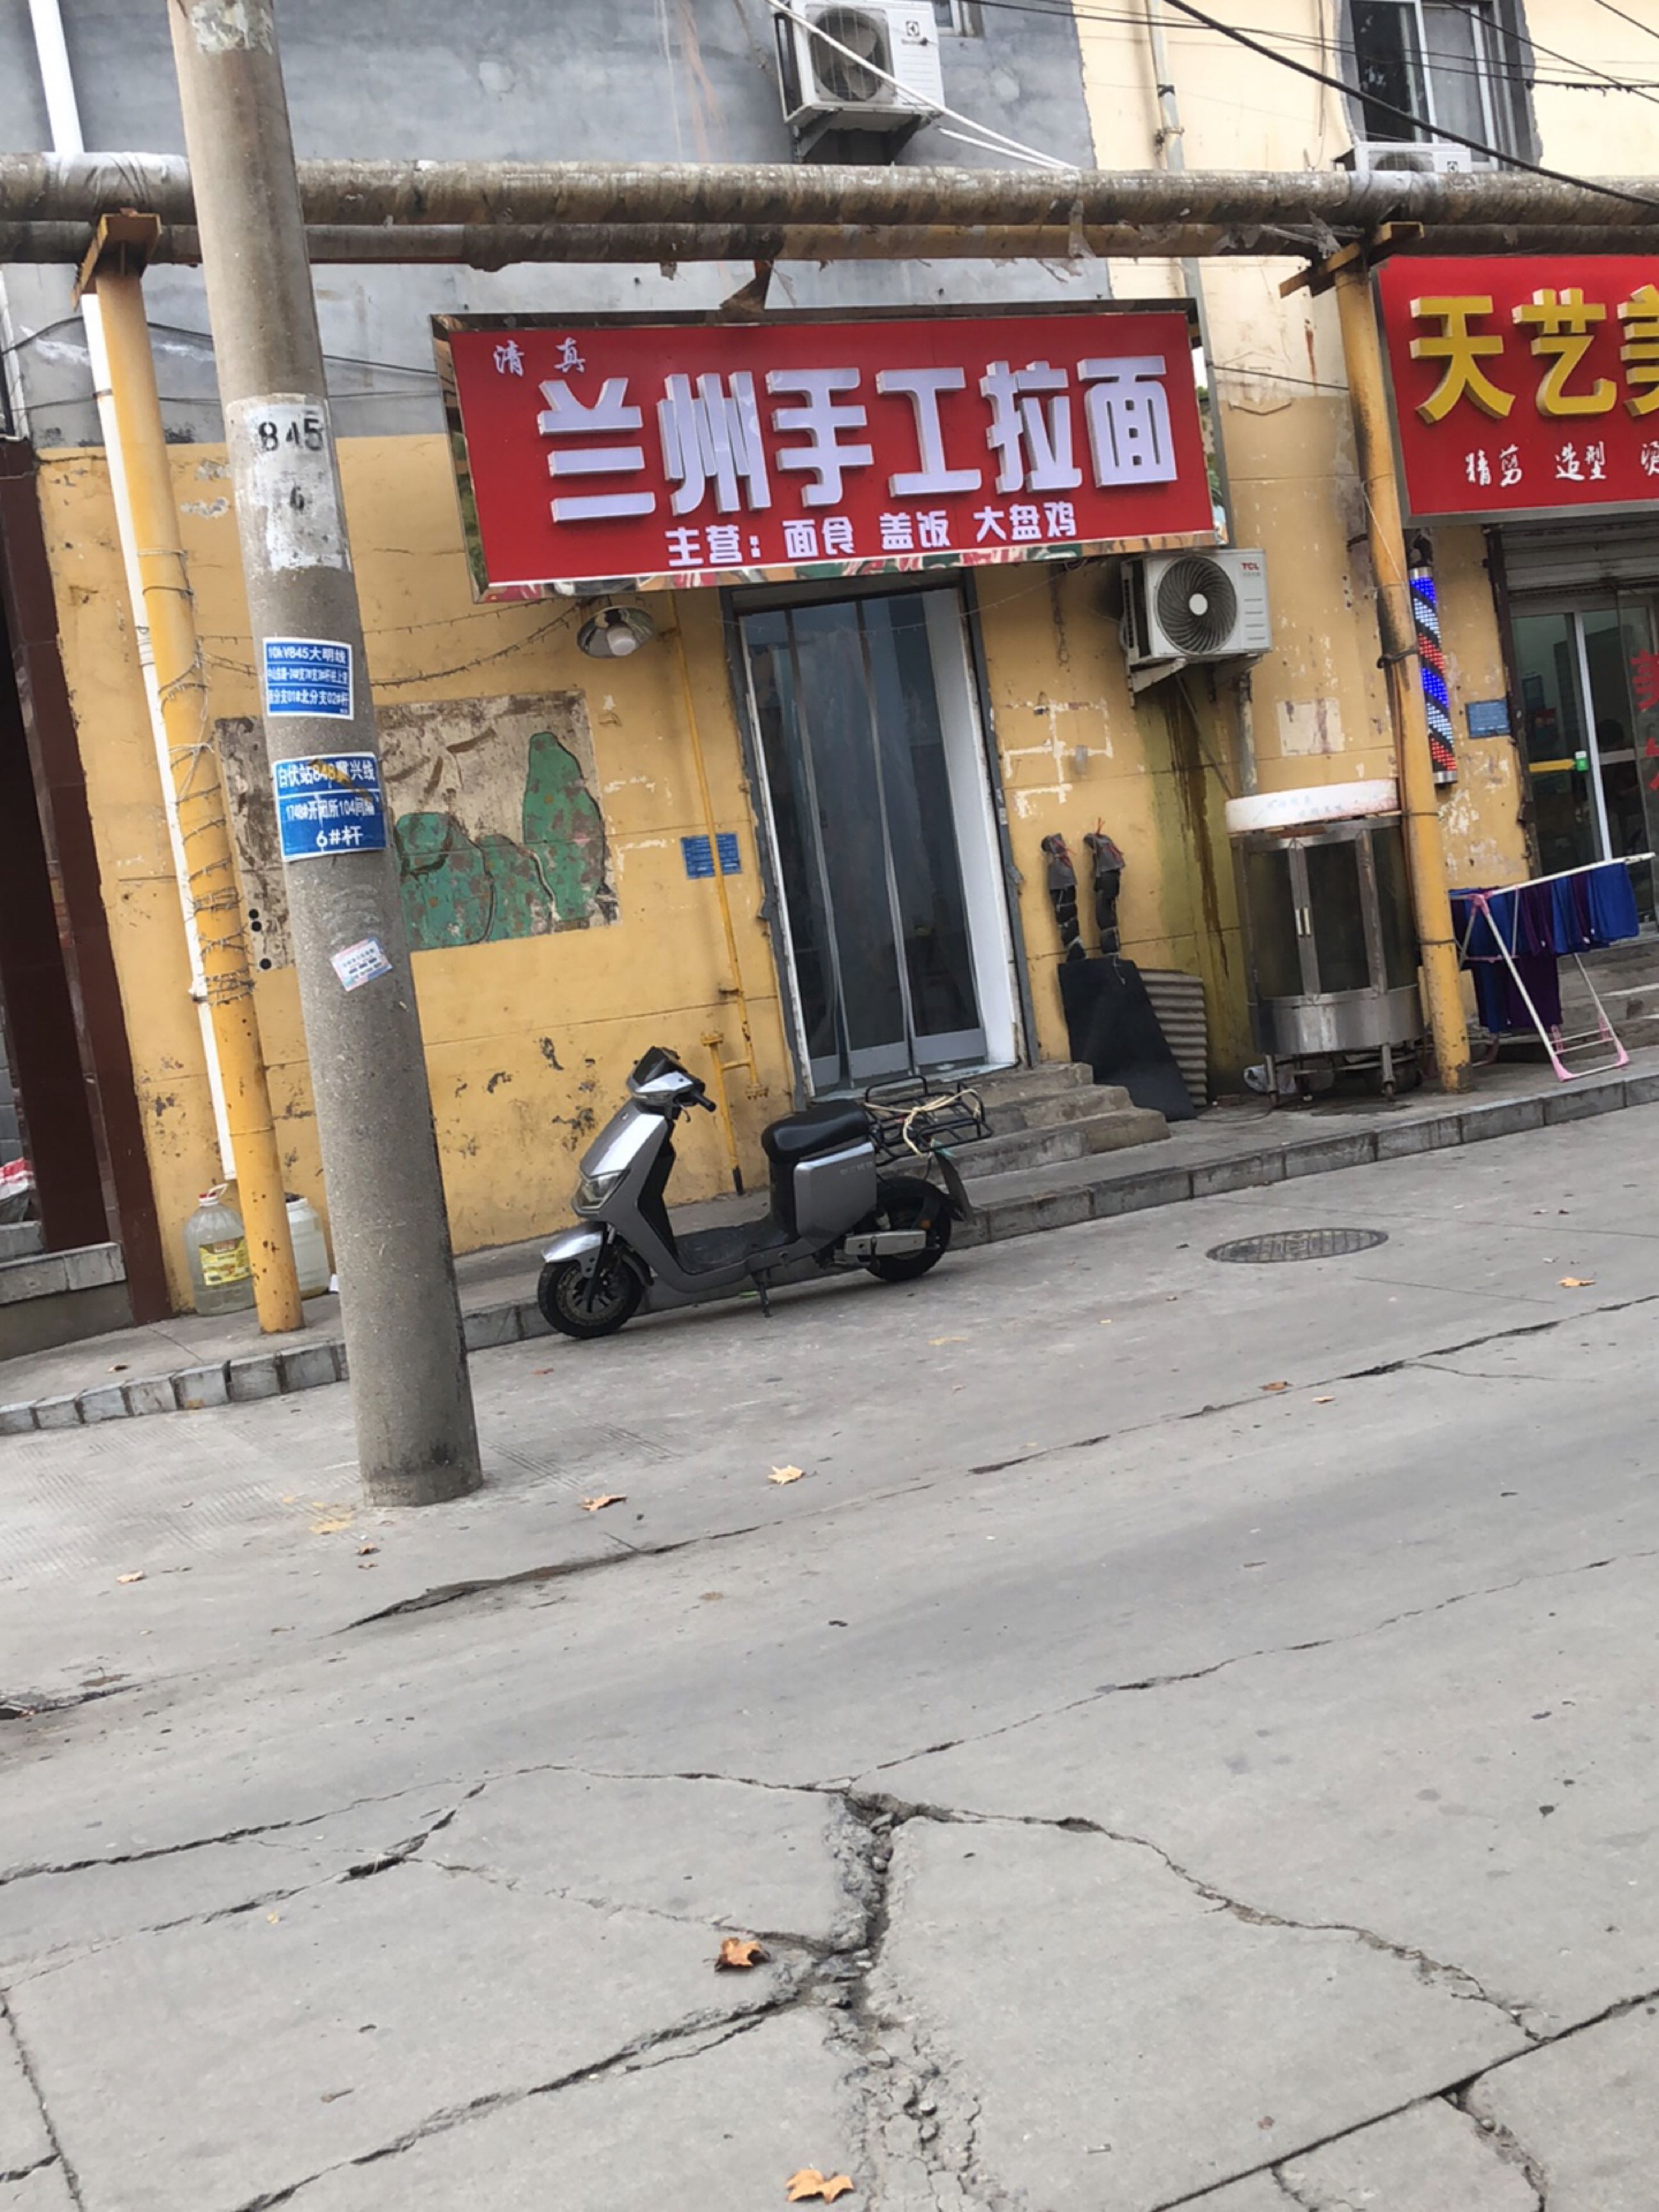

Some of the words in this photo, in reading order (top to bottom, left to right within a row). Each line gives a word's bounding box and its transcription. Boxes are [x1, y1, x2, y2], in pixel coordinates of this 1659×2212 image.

[493, 337, 586, 377] 清真
[259, 418, 323, 451] 845
[537, 355, 1177, 524] 兰州手工拉面
[1464, 444, 1523, 487] 精剪
[1554, 440, 1607, 481] 造型
[782, 515, 856, 559] 面食
[880, 509, 951, 550] 盖饭
[974, 501, 1078, 543] 大盘鸡
[1240, 562, 1260, 571] TCL
[316, 825, 364, 847] 6#杆
